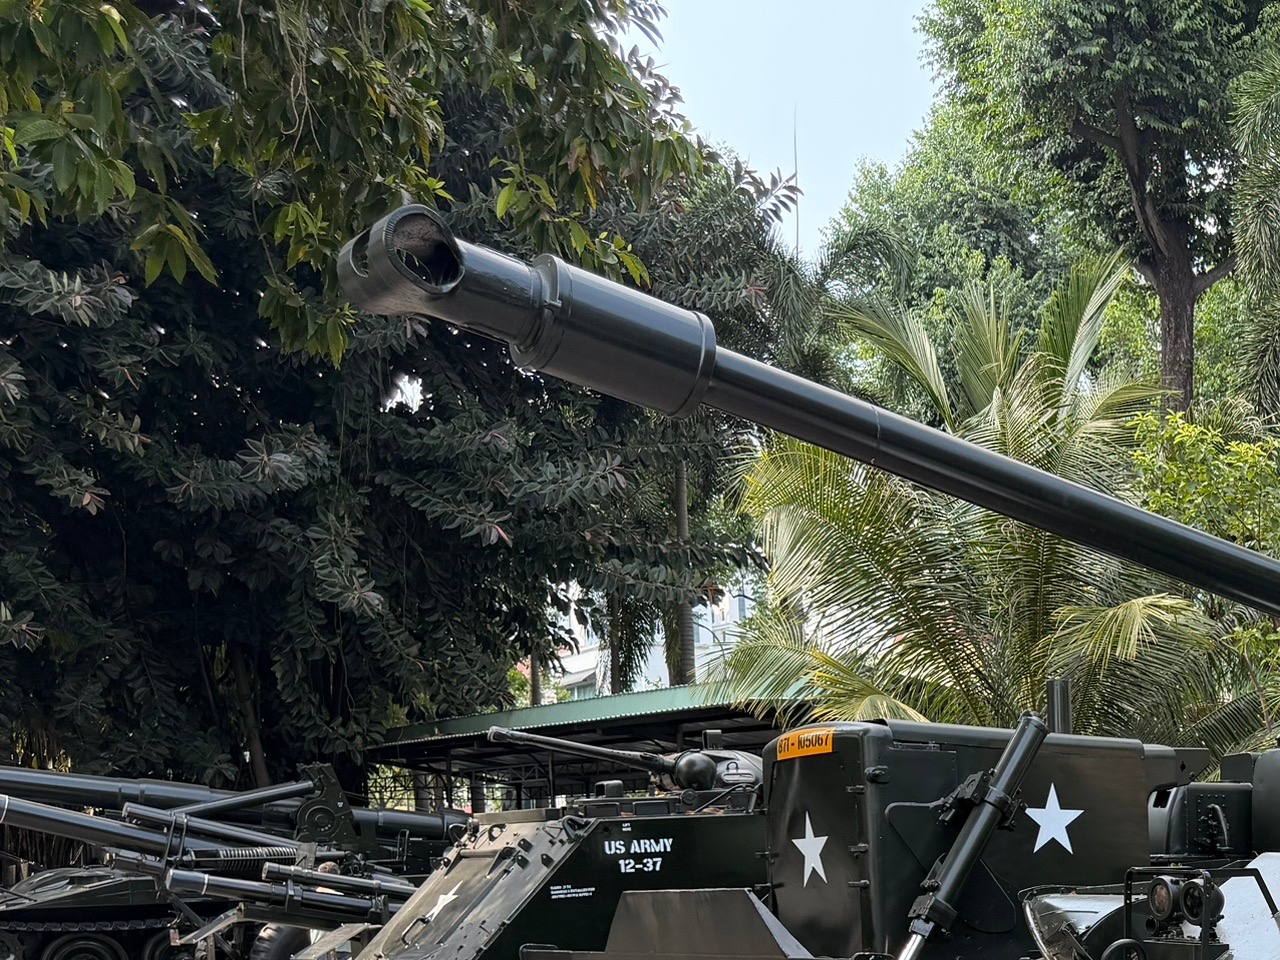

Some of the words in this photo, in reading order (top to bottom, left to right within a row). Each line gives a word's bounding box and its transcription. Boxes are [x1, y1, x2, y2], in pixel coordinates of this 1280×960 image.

[604, 840, 626, 855] US
[630, 838, 673, 854] ARMY
[618, 857, 663, 873] 12-37
